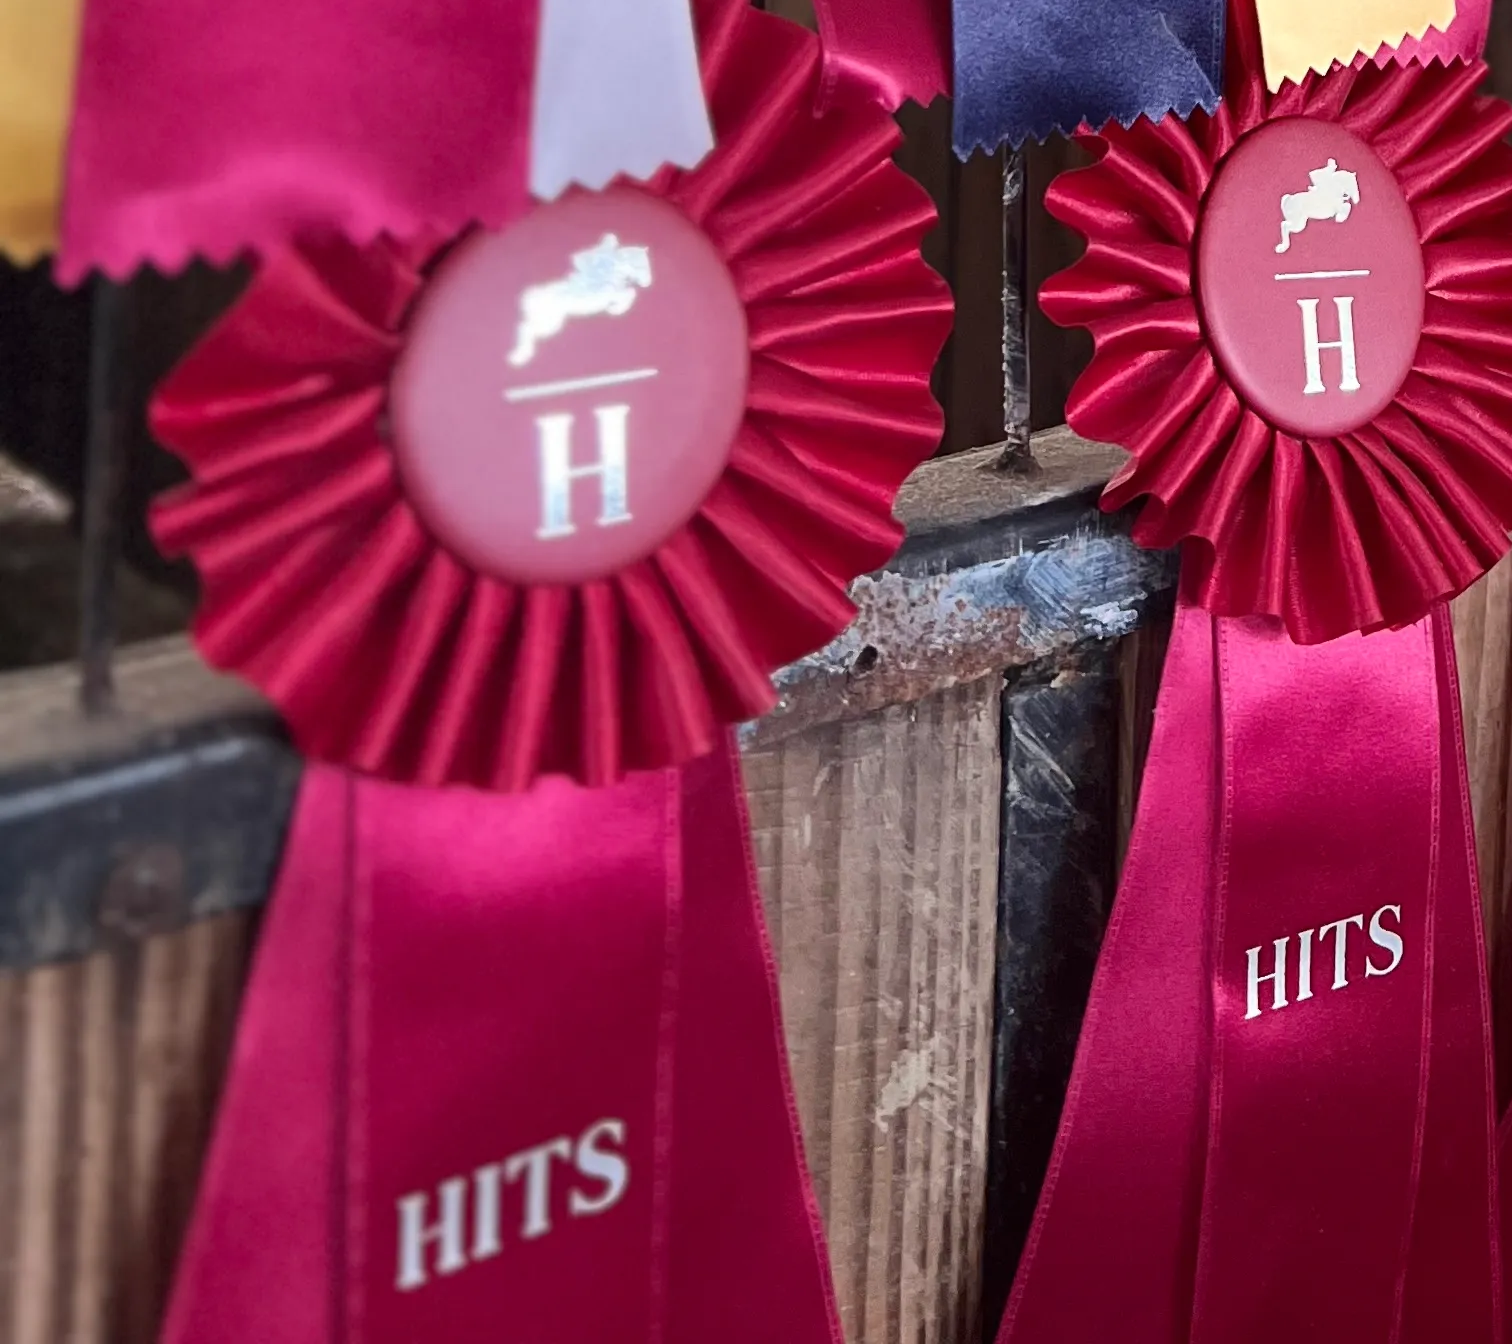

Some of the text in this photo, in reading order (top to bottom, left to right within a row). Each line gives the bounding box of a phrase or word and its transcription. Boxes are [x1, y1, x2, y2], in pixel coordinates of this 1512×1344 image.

[1296, 296, 1361, 395] H
[534, 405, 633, 539] H
[1243, 904, 1403, 1021] HITS
[394, 1120, 629, 1292] HITS
